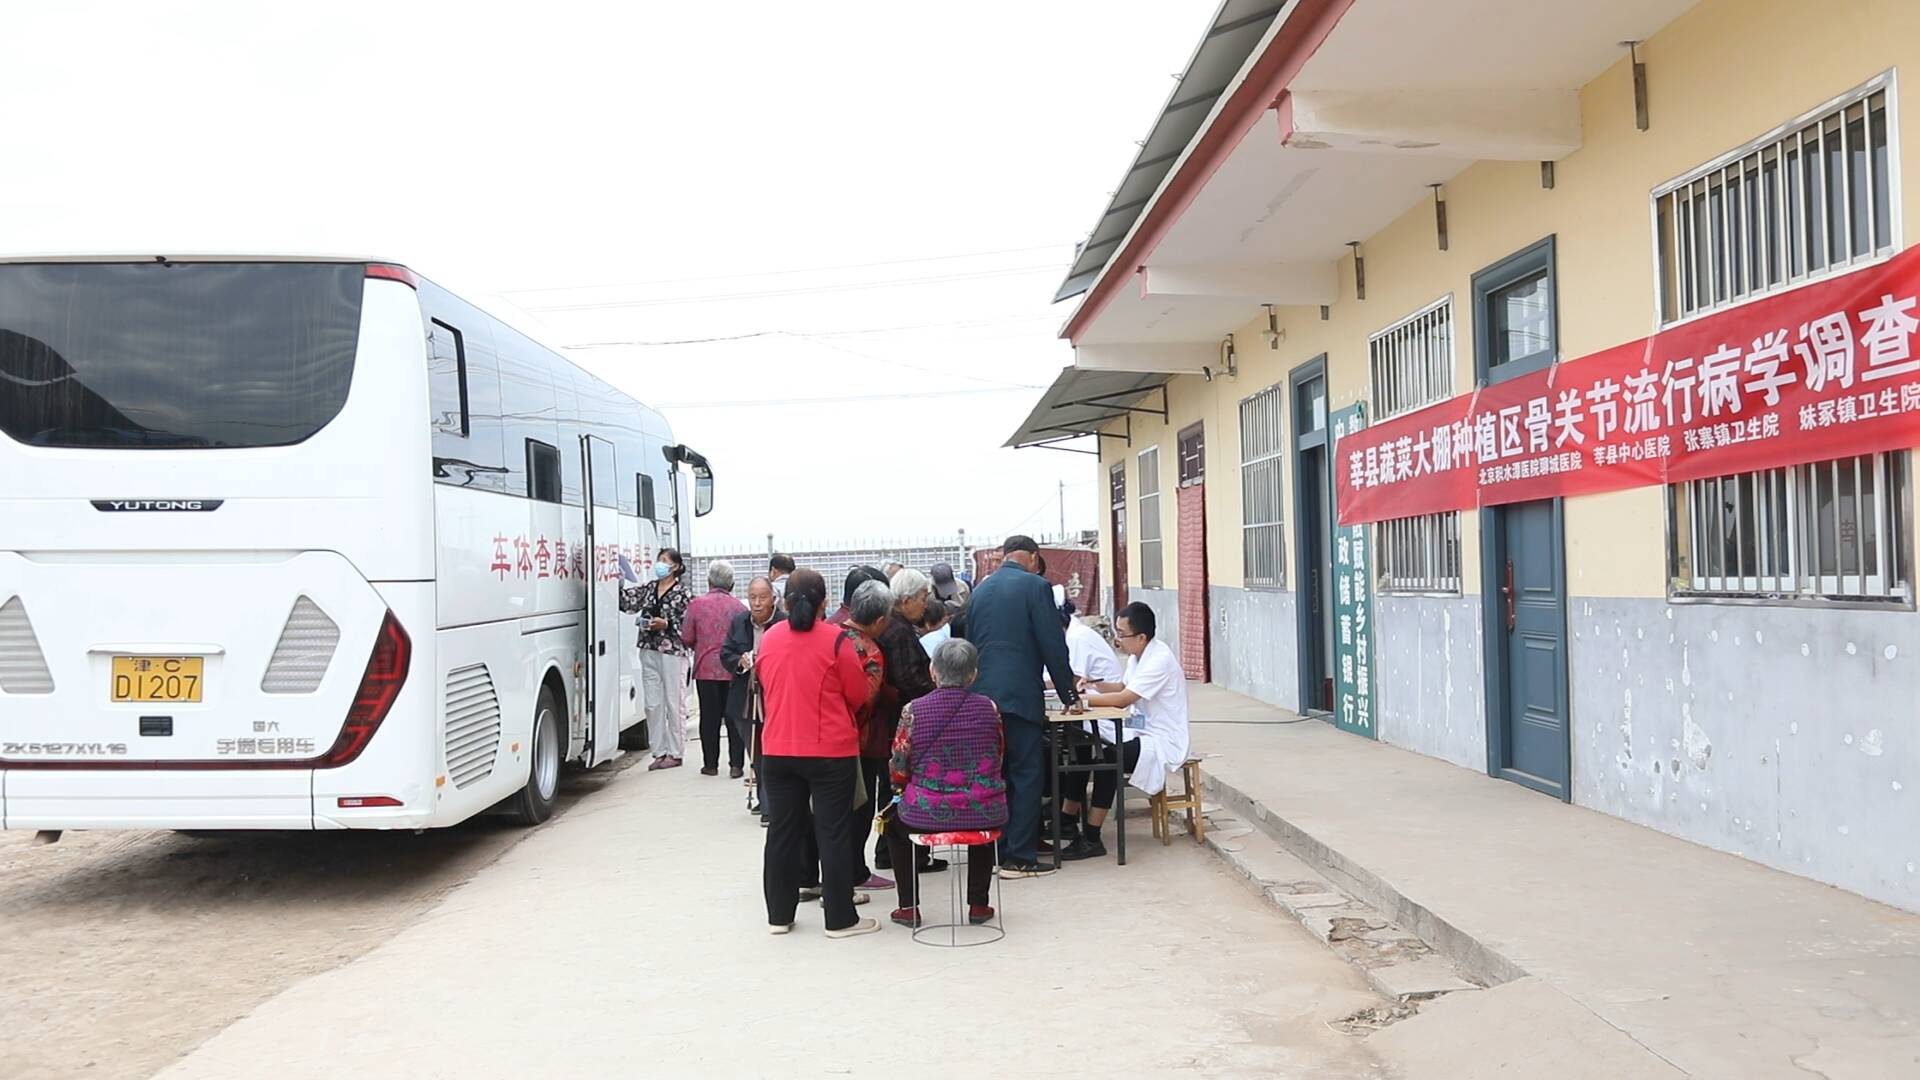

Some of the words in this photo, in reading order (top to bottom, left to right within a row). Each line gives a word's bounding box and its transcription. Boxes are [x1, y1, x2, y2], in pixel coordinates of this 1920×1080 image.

[1350, 293, 1920, 491] 莘县蔬菜大棚种植区骨关节流行病学调查
[1593, 434, 1671, 466] 莘县中心医院
[1684, 412, 1779, 452] 张寨镇卫生院
[110, 501, 202, 510] YUTONG
[116, 675, 198, 699] D1207
